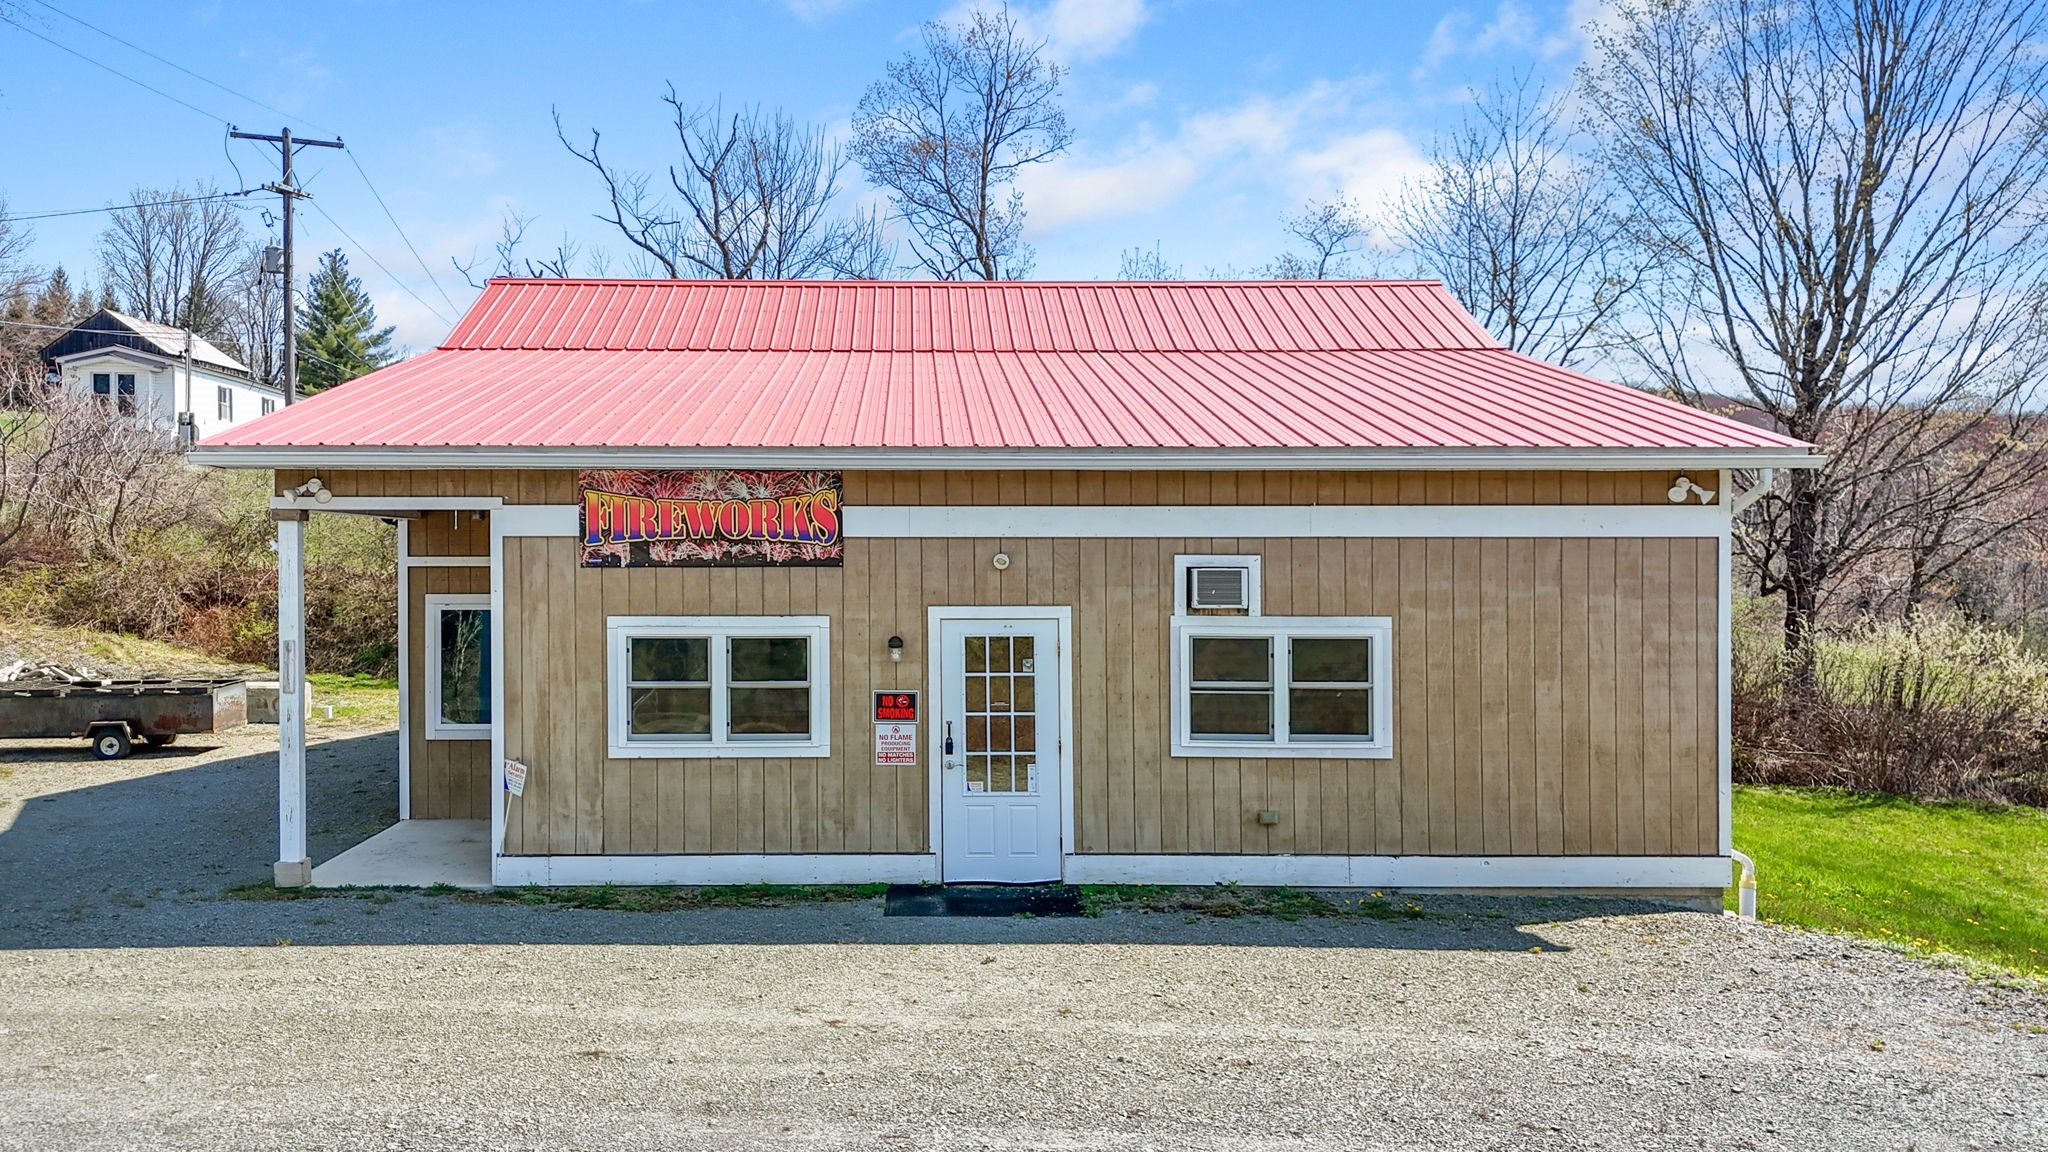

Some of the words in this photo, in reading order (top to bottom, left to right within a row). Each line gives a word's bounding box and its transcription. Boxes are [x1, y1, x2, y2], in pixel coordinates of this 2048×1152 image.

[583, 489, 839, 546] FIREWORKS
[882, 695, 894, 706] NO
[877, 707, 914, 719] SMOKING
